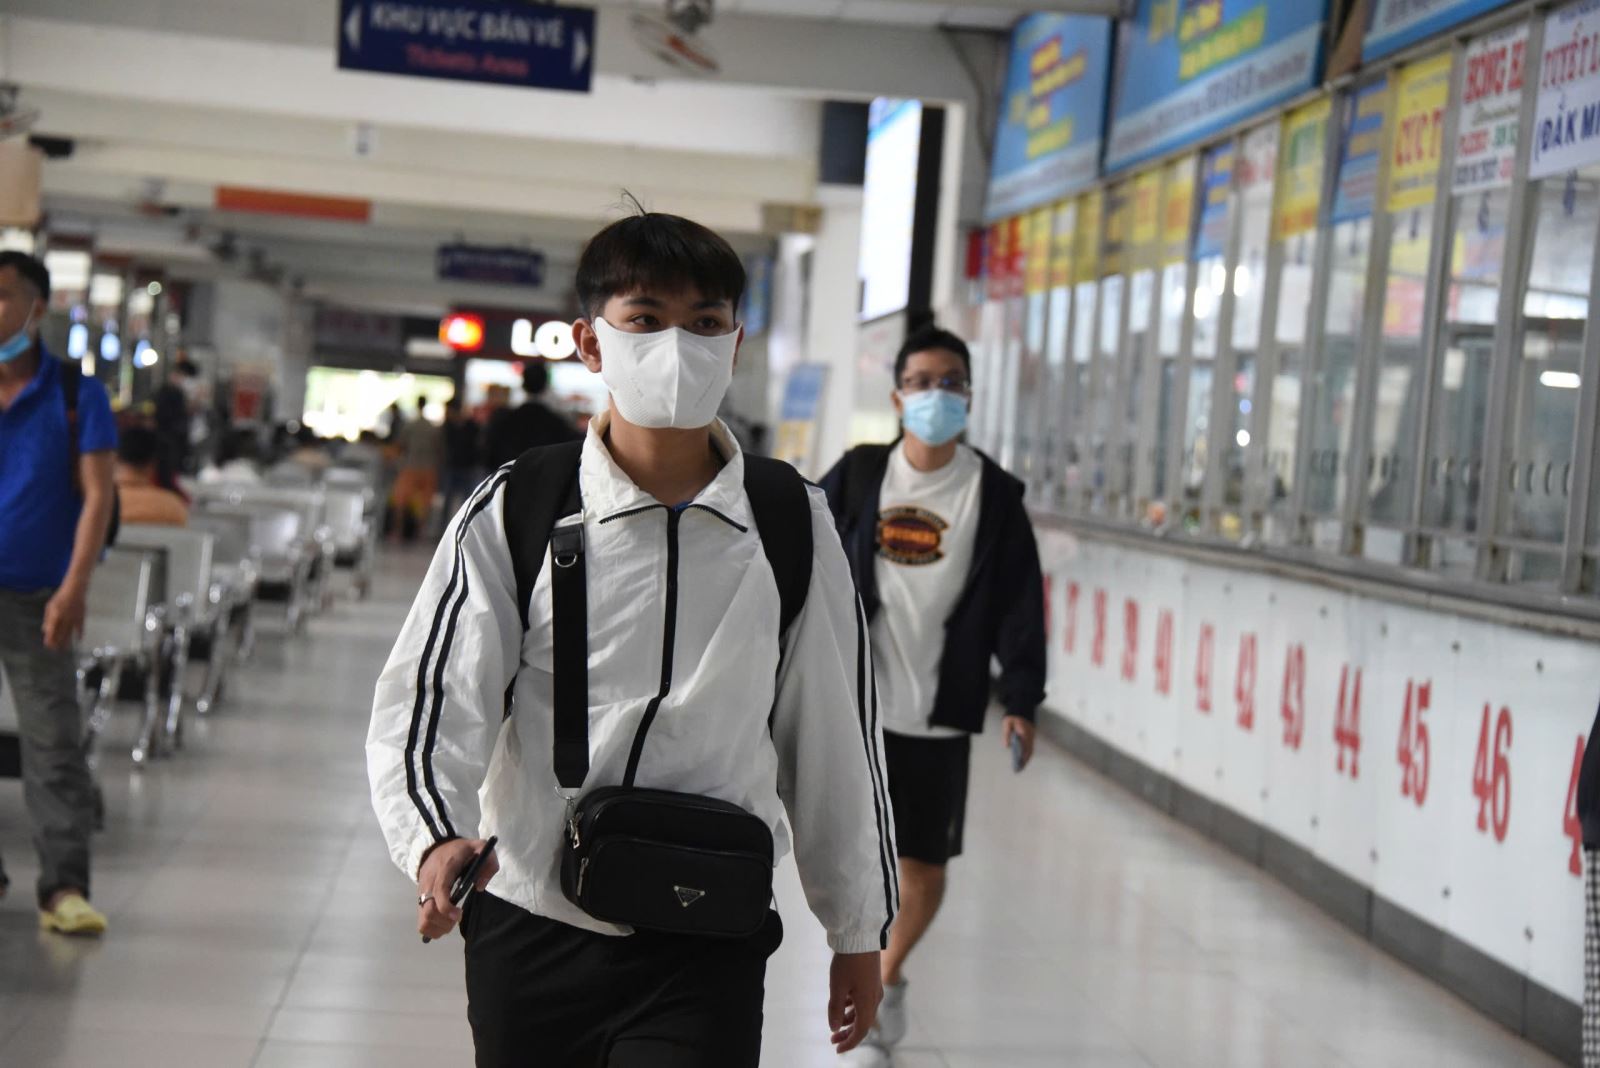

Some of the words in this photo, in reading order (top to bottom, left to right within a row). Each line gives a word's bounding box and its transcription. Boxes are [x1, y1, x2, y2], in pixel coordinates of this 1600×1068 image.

[370, 2, 424, 33] KHU
[479, 11, 529, 43] BÁN
[511, 318, 577, 360] LO
[1234, 631, 1259, 732] 42
[1280, 642, 1306, 752] 43
[1334, 662, 1363, 780] 44
[1397, 678, 1432, 809] 45
[1472, 702, 1513, 843] 46
[1562, 733, 1587, 878] 4
